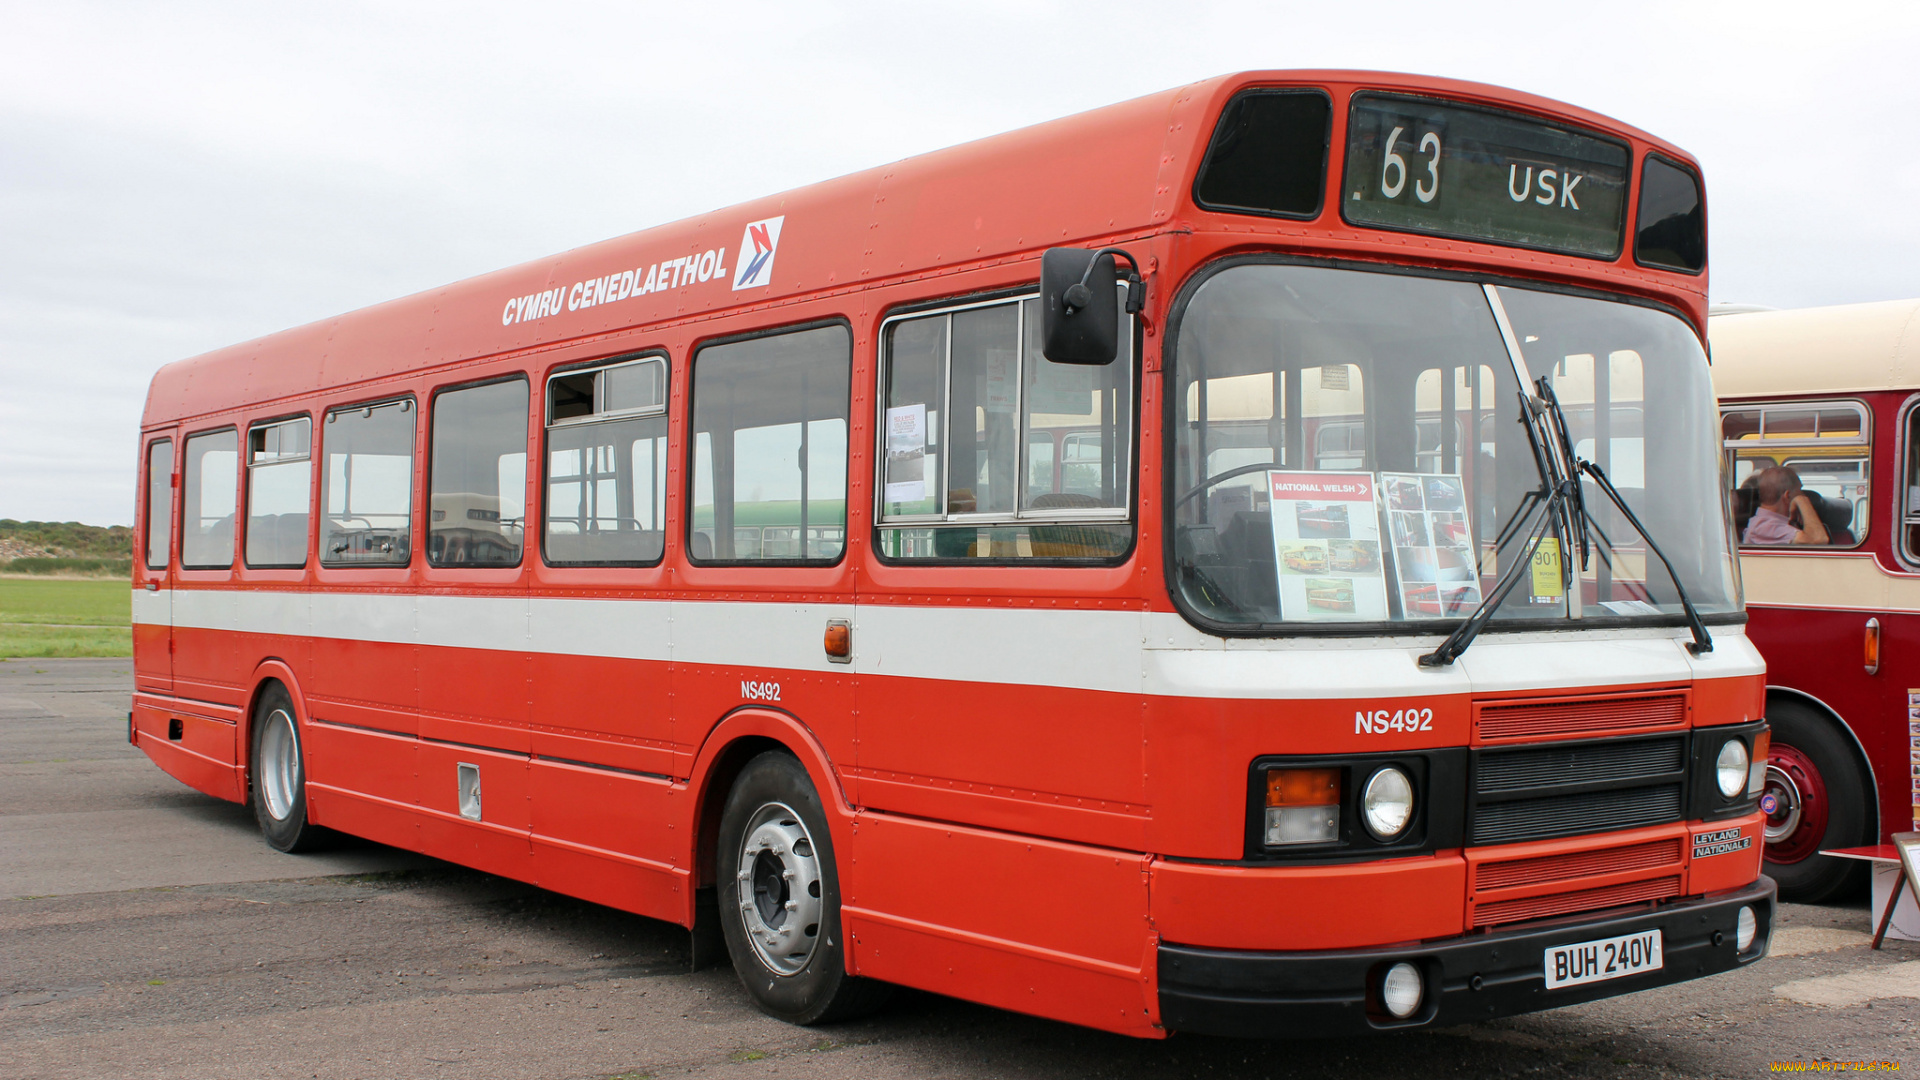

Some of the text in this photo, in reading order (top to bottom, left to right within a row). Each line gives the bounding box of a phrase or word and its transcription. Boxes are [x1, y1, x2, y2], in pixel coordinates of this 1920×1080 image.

[1381, 126, 1583, 210] 63 USK
[502, 247, 727, 326] CYMRU CENEDLAETHOL
[1275, 483, 1356, 493] NATIONAL WELSH
[1534, 551, 1558, 566] 901
[741, 680, 781, 701] NS492
[1354, 708, 1433, 735] NS492
[1695, 829, 1739, 844] LEYLAND
[1696, 838, 1749, 857] NATIONAL 2
[1555, 935, 1653, 981] BUH 240V
